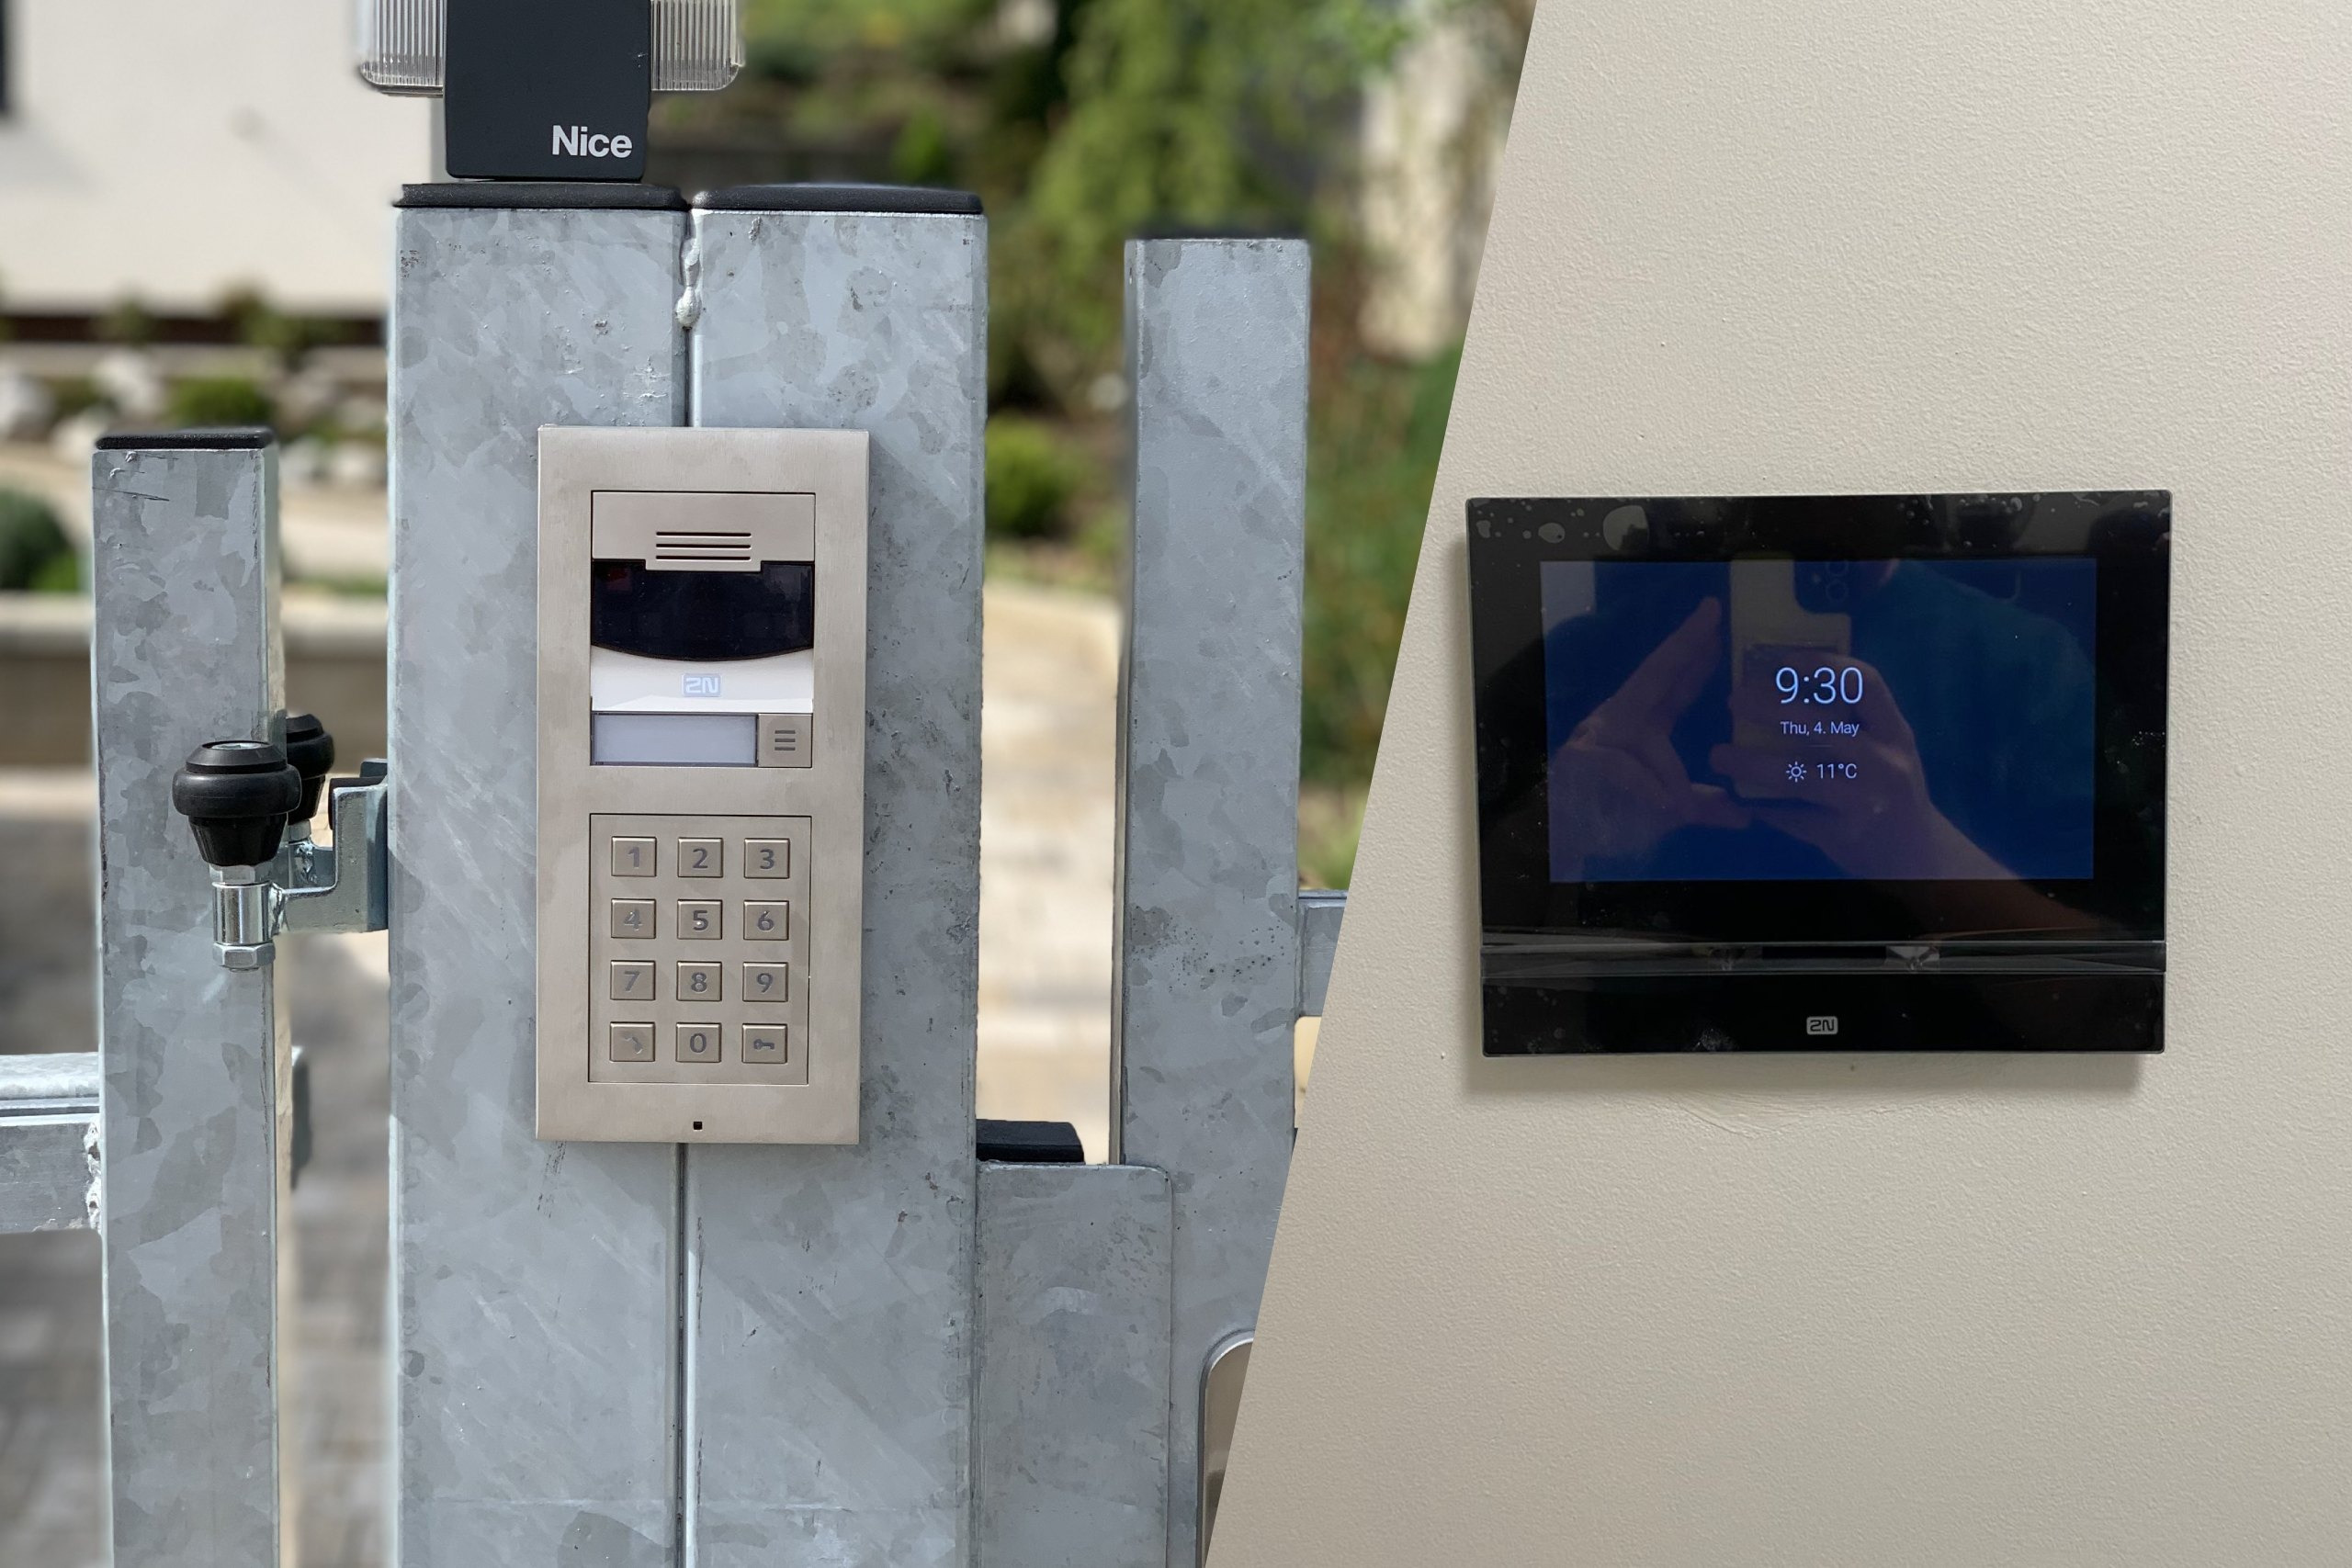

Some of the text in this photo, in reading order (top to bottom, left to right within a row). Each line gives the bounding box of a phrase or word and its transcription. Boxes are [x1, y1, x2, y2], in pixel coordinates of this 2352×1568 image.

[552, 124, 633, 158] Nice
[685, 676, 719, 694] 2N
[1775, 667, 1863, 705] 9:30
[1780, 721, 1860, 738] Thu, 4. May
[1816, 763, 1858, 779] 11°C
[627, 846, 775, 870] 1 2 3
[623, 908, 775, 931] 4 5 6
[623, 970, 774, 994] 7 8 9
[1809, 1018, 1835, 1032] 2N
[689, 1032, 707, 1054] 0
